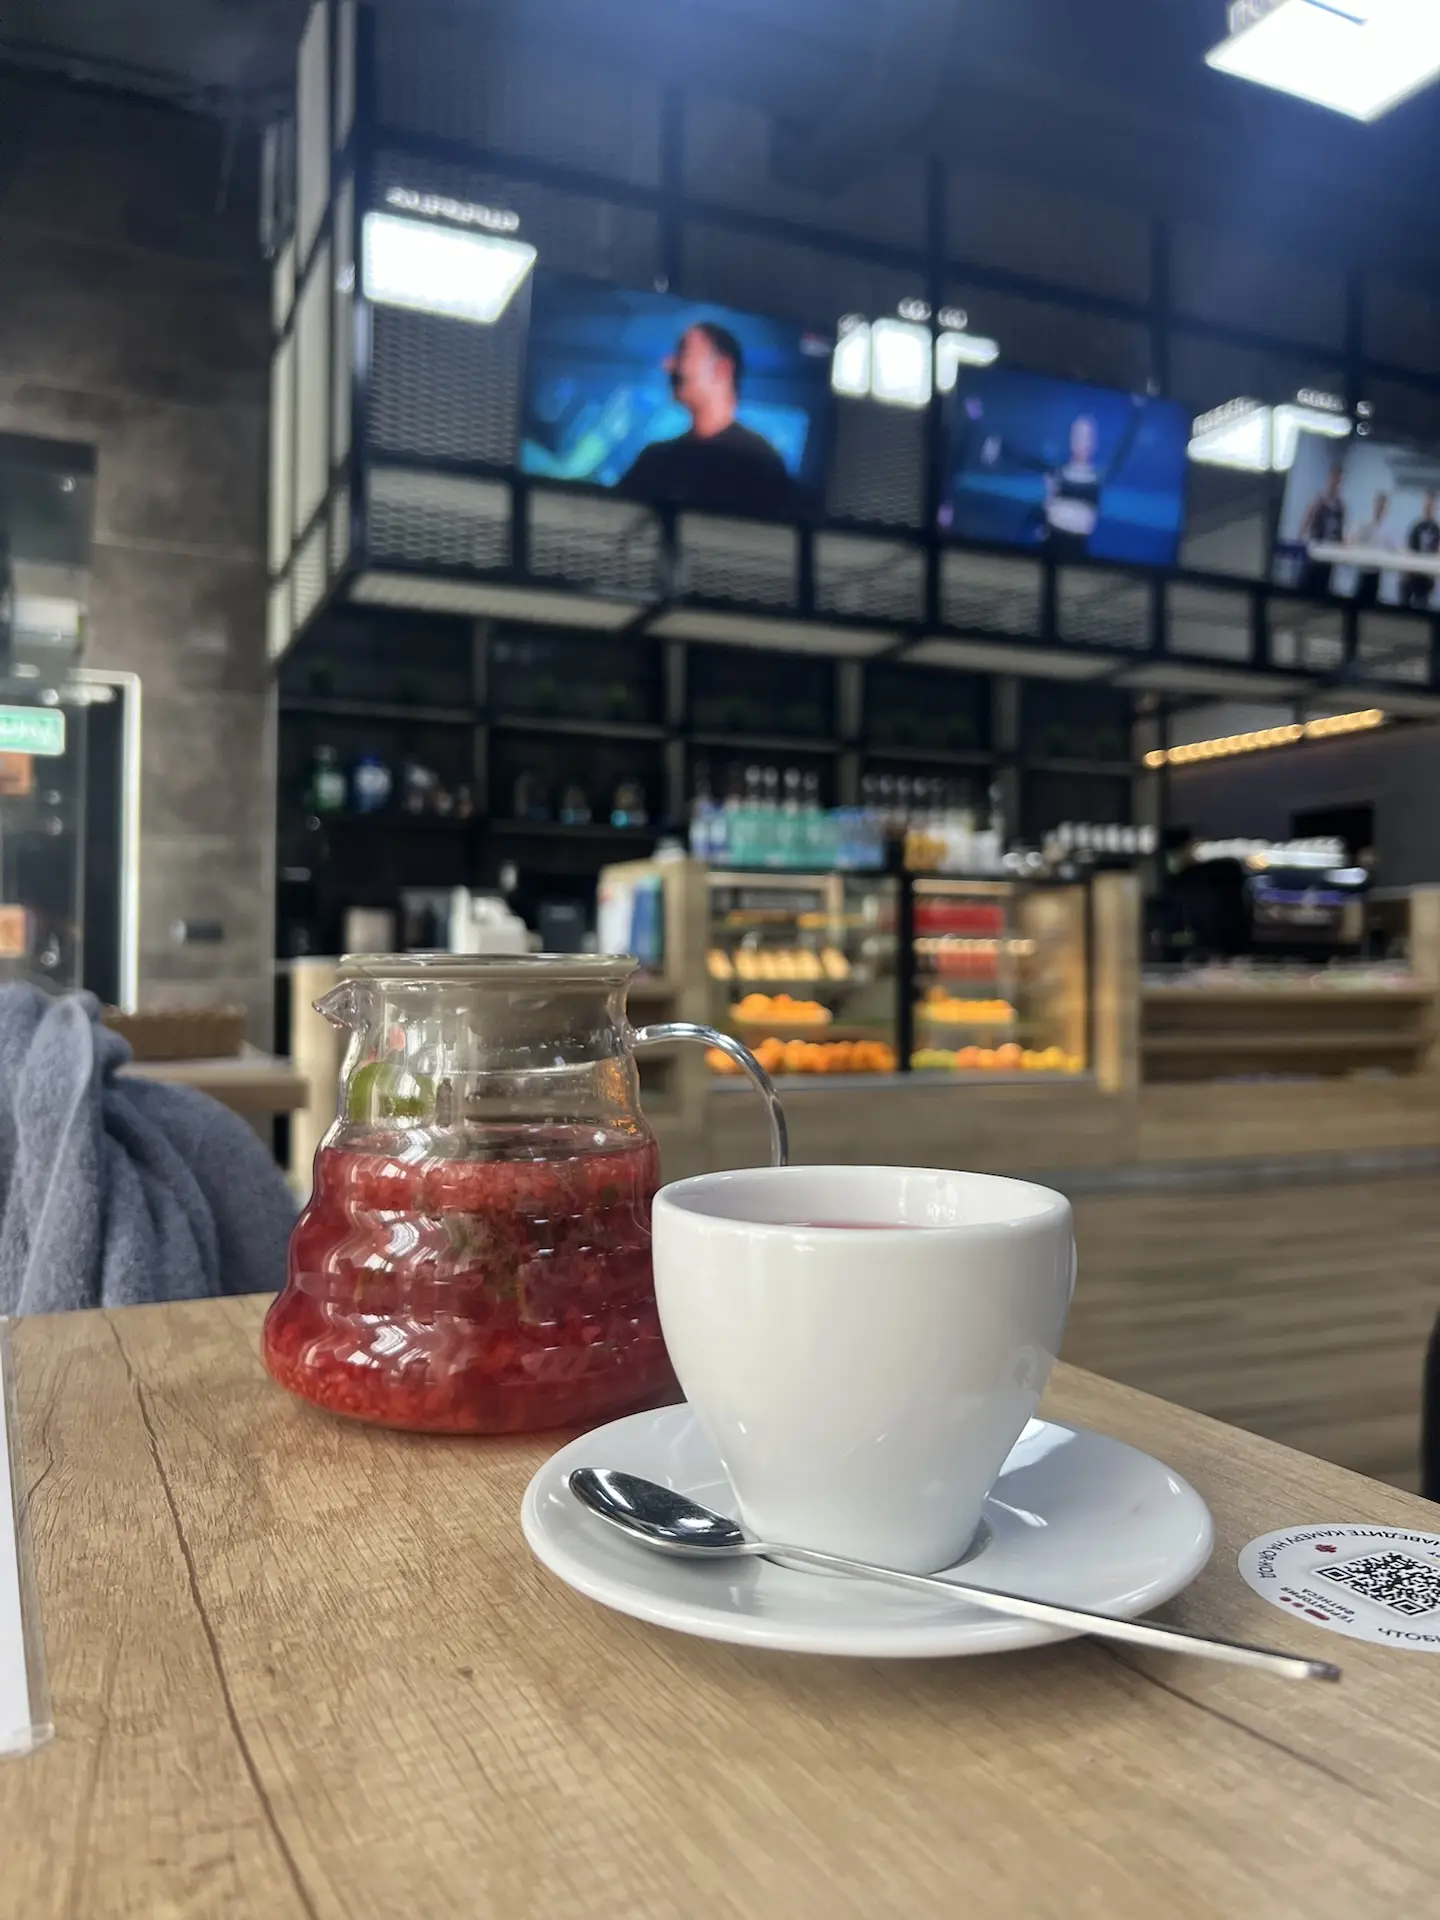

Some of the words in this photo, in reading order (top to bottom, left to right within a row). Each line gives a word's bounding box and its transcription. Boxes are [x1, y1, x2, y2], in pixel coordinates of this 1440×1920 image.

[1266, 1540, 1291, 1551] НА
[1285, 1529, 1346, 1545] КАМЕРУ
[1256, 1549, 1277, 1578] QR-КОД
[1280, 1586, 1355, 1623] ТЕРРИТОРИЯ
[1301, 1588, 1355, 1615] ФИТНЕСА
